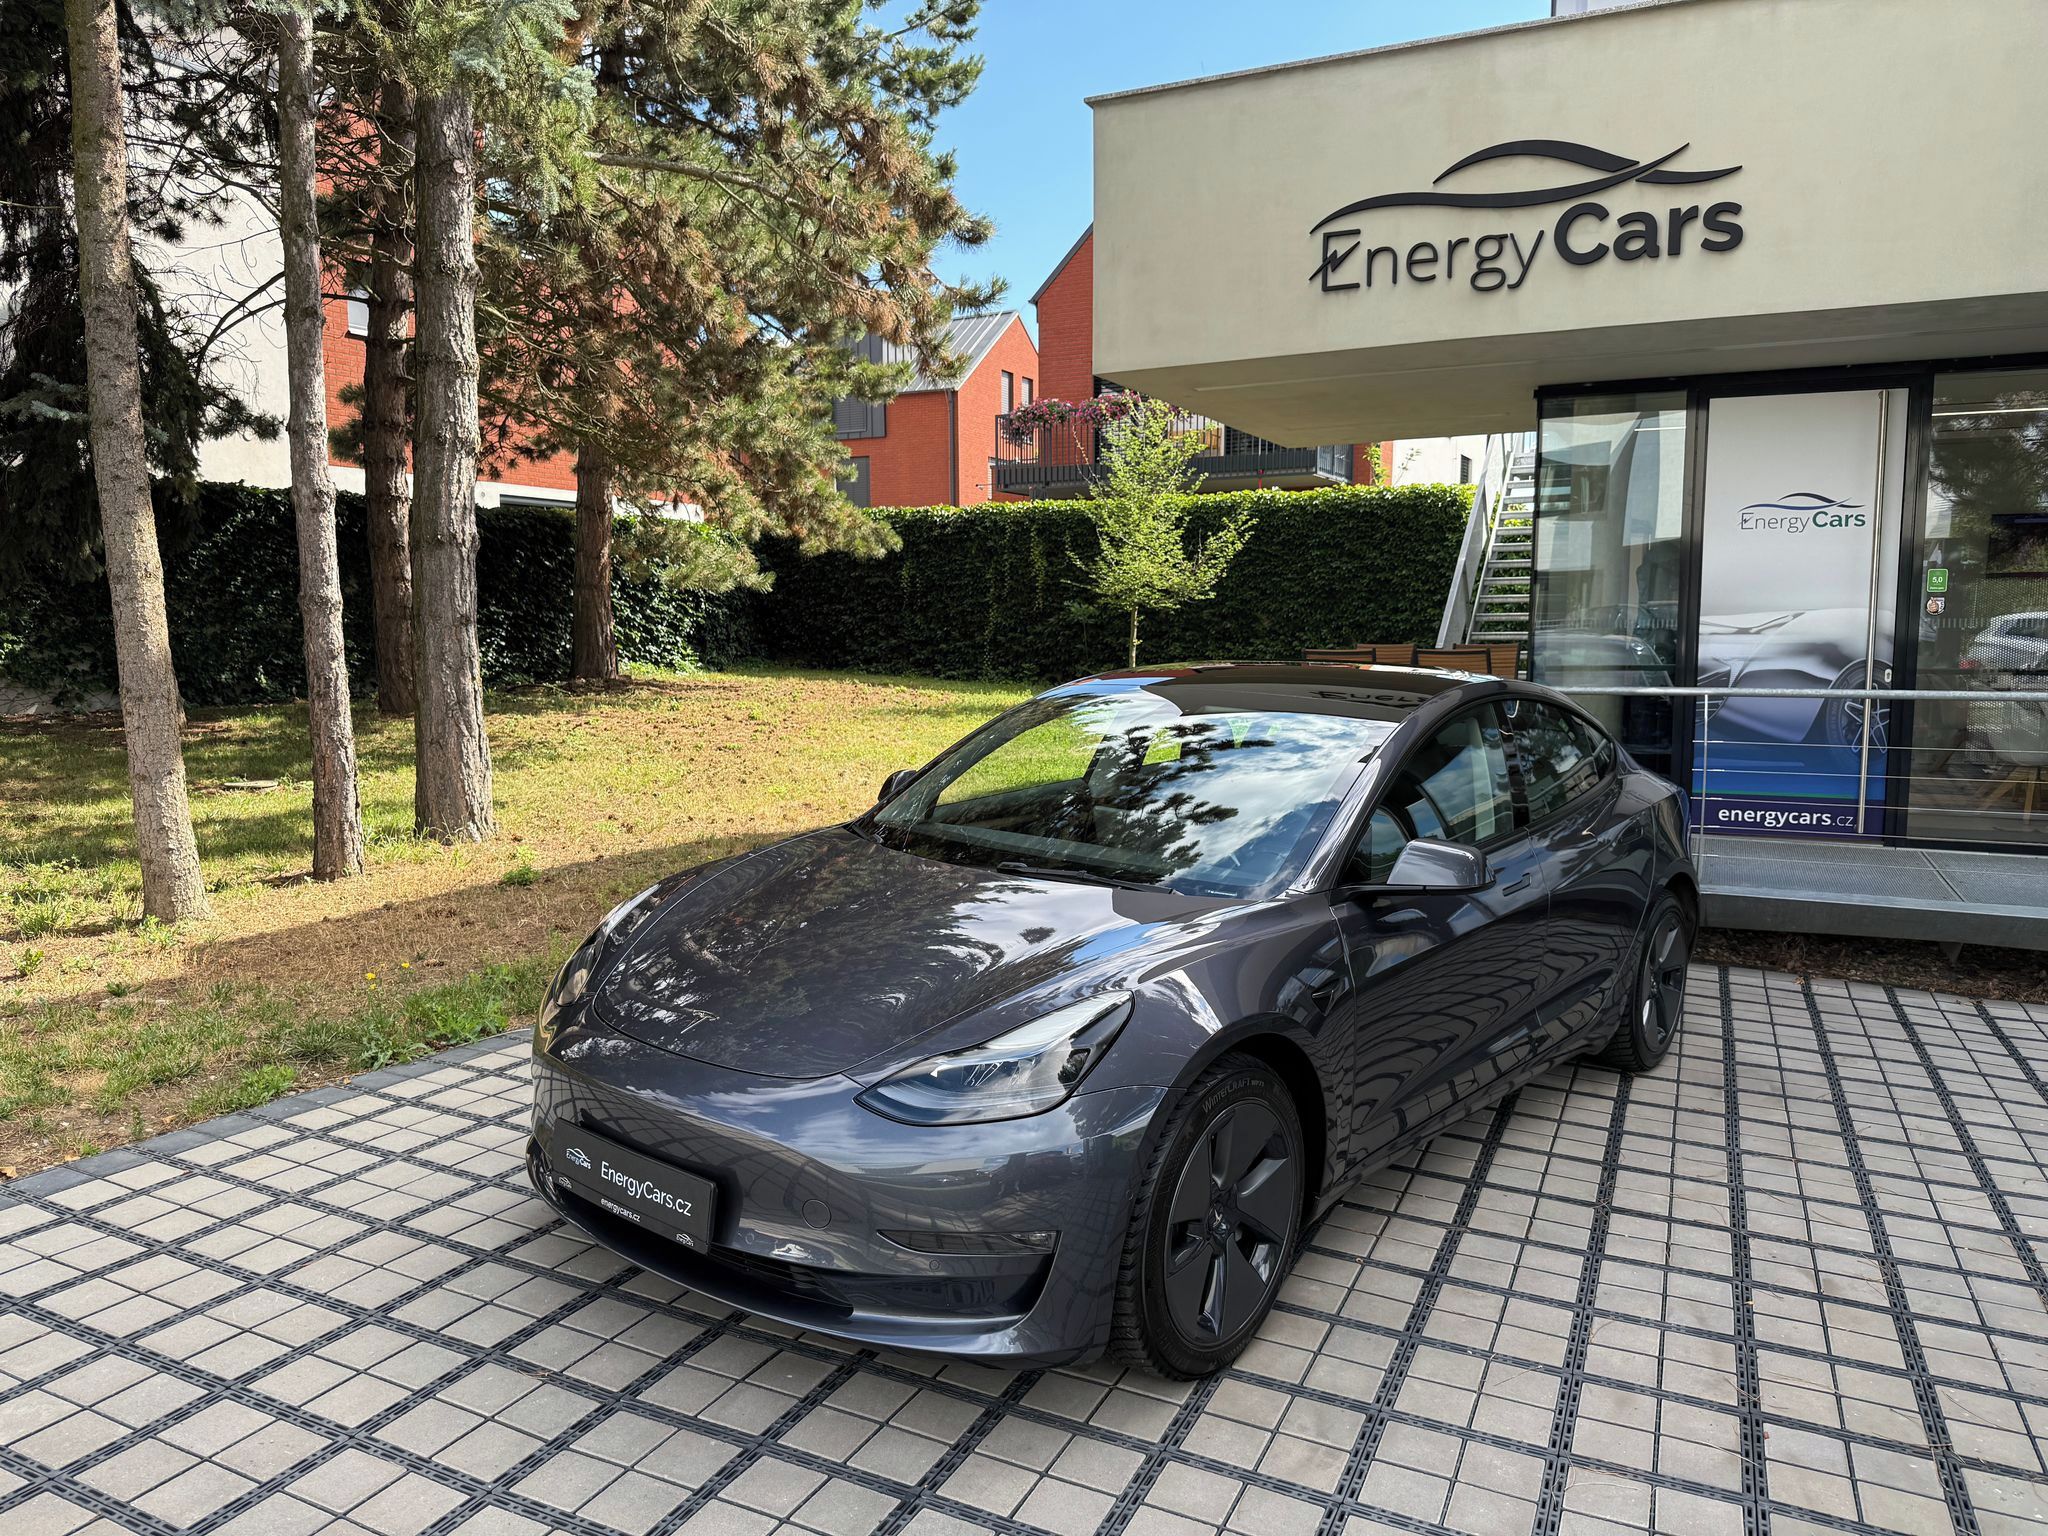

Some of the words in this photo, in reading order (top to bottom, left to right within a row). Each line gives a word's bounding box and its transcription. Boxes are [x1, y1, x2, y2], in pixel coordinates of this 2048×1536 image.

[1312, 201, 1744, 292] EnergyCars
[1739, 511, 1866, 534] EnergyCars
[1718, 808, 1854, 828] energycars.cz
[601, 1161, 692, 1217] EnergyCars.cz
[600, 1198, 641, 1222] energycars.cz
